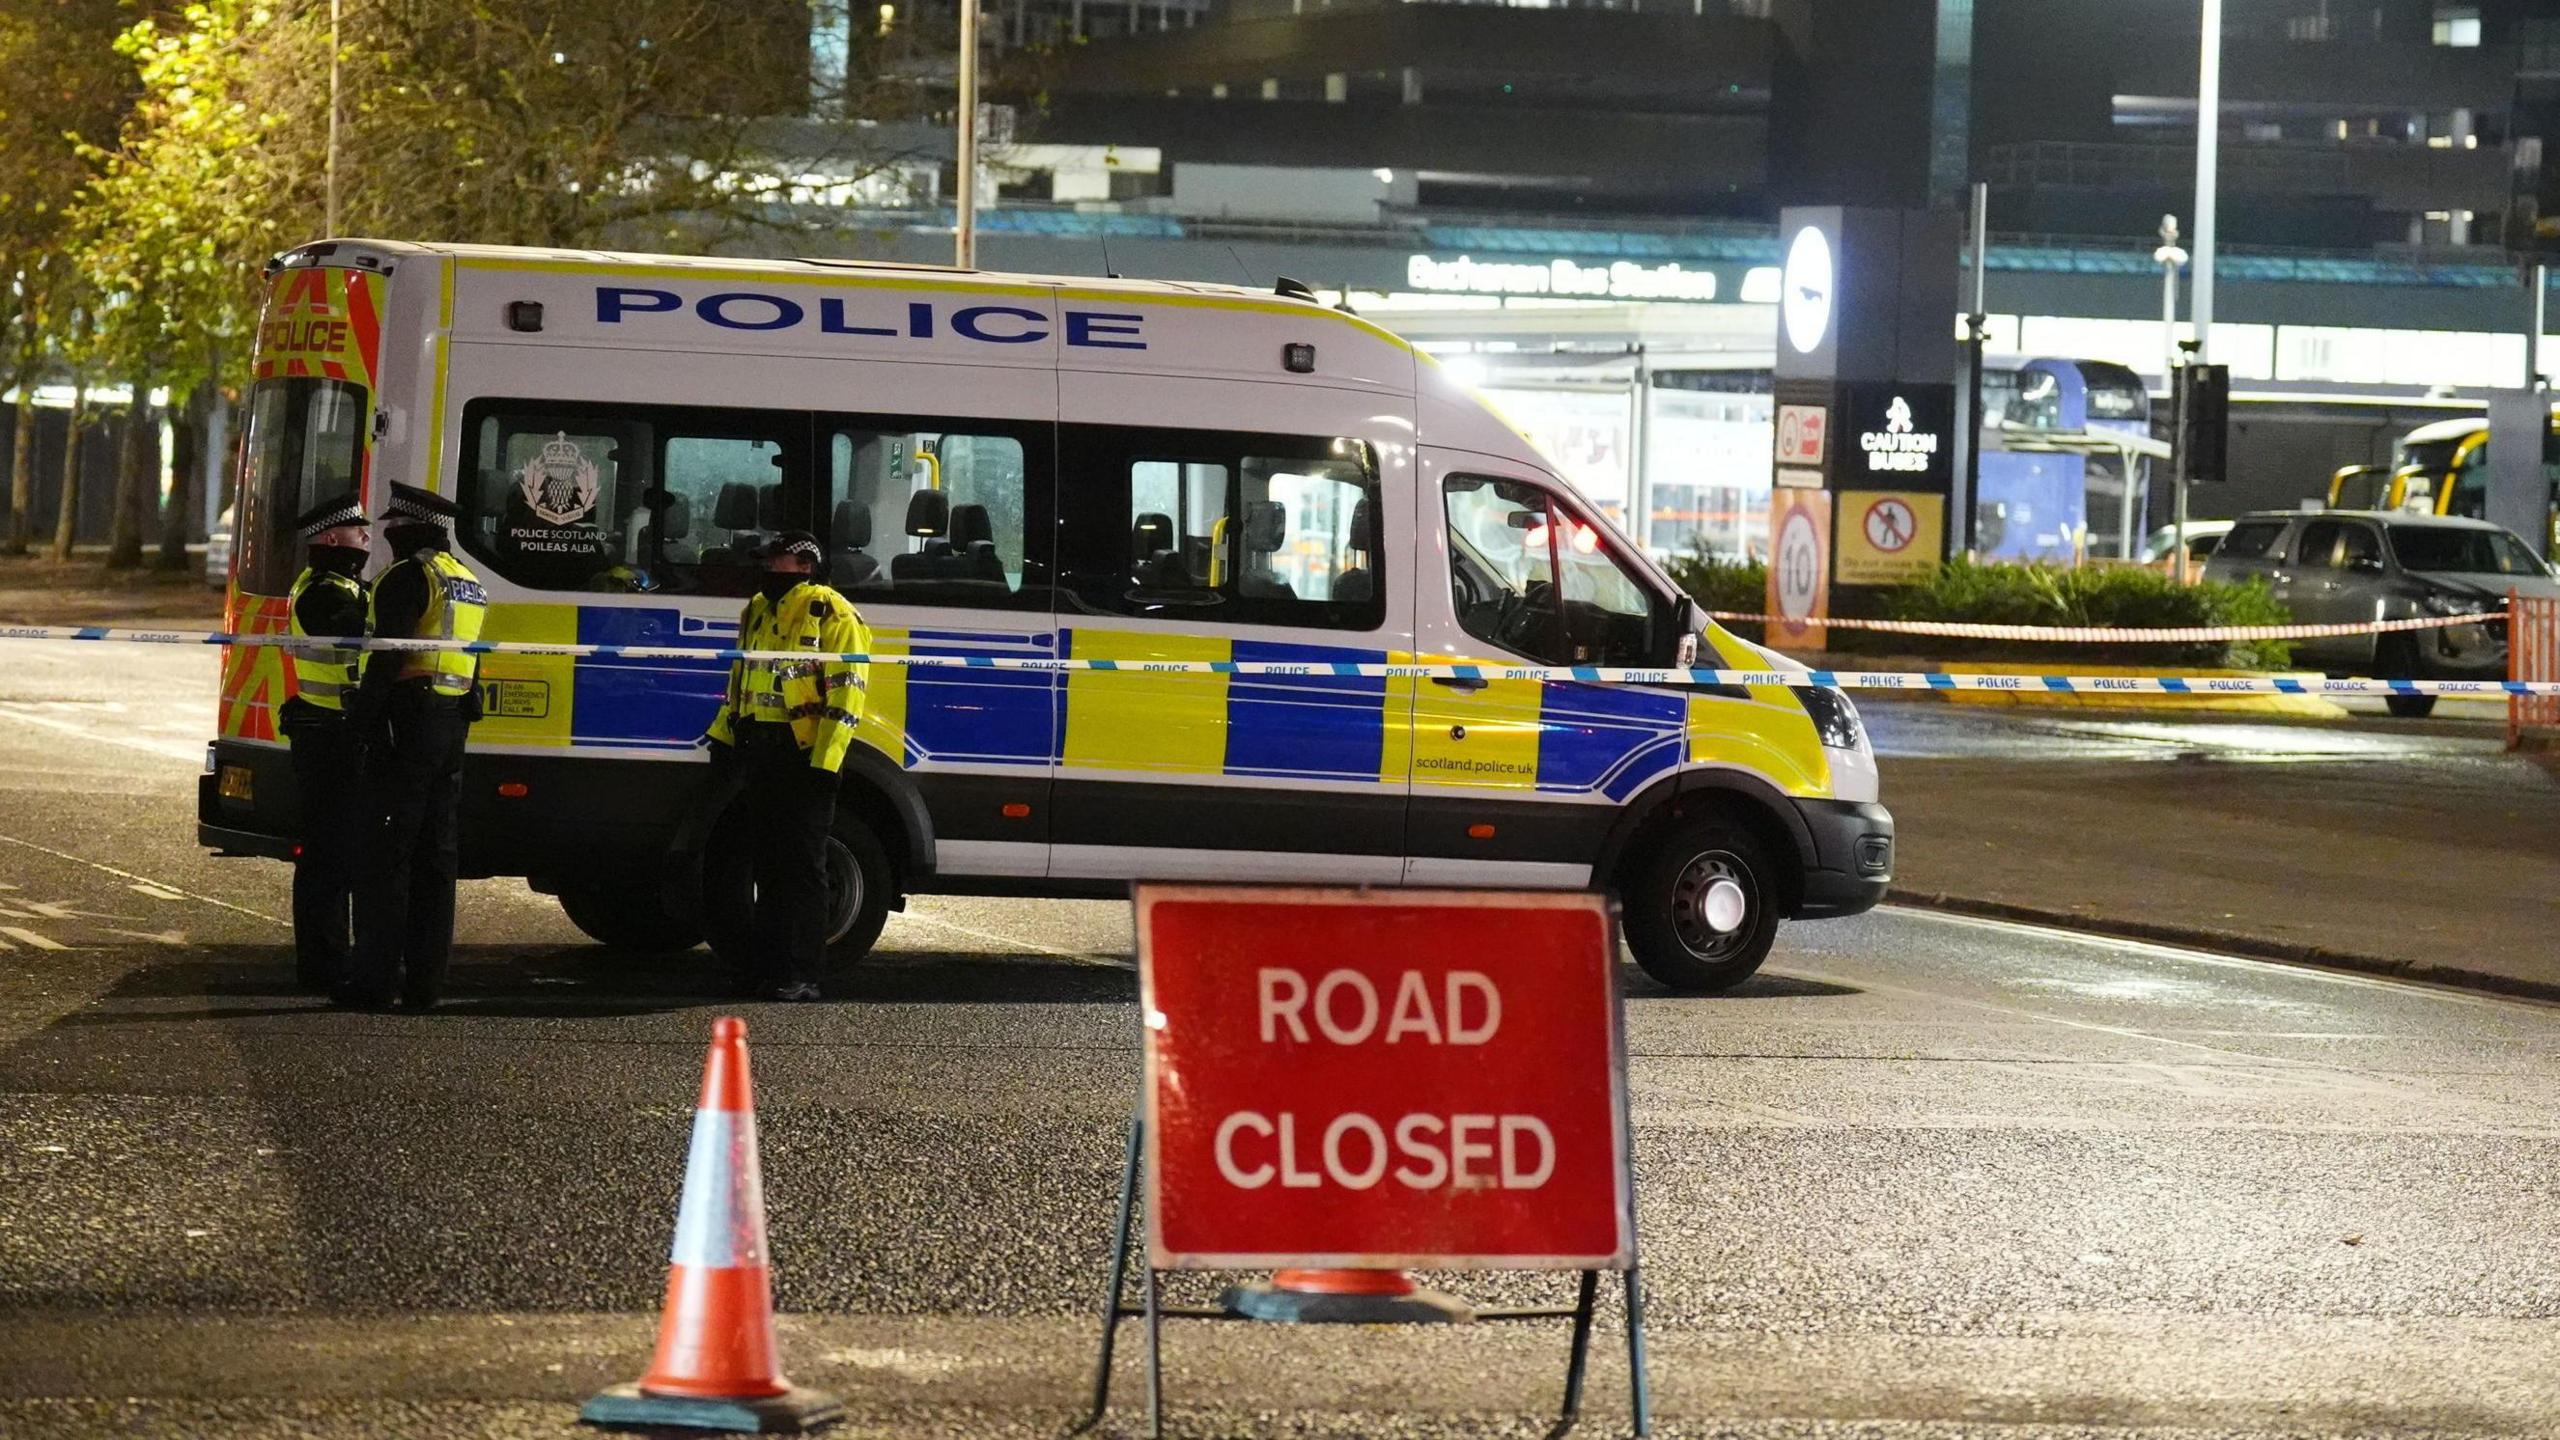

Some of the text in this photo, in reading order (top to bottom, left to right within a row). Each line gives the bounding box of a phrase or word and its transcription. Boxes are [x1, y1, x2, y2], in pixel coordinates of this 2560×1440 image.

[1551, 259, 1608, 295] Bus
[1609, 262, 1716, 299] Station
[596, 286, 1148, 350] POLICE
[261, 320, 348, 353] POLICE
[1861, 432, 1937, 453] CAUTION
[511, 528, 607, 541] POLICE SCOTLAND
[520, 541, 596, 553] POILEAS ALBA
[1784, 546, 1811, 595] 10
[1265, 666, 1310, 676] POLICE
[1386, 668, 1431, 678] POLICE
[1505, 669, 1550, 681] POLICE
[1624, 671, 1669, 683] POLICE
[1742, 673, 1787, 686] POLICE
[1860, 675, 1904, 687] POLICE
[1977, 677, 2022, 689] POLICE
[2094, 678, 2137, 690] POLICE
[2209, 680, 2254, 690] POLICE
[2324, 681, 2369, 691] POLICE
[1416, 757, 1534, 775] scotland.police.uk
[1258, 967, 1502, 1046] ROAD
[1214, 1110, 1556, 1190] CLOSED
